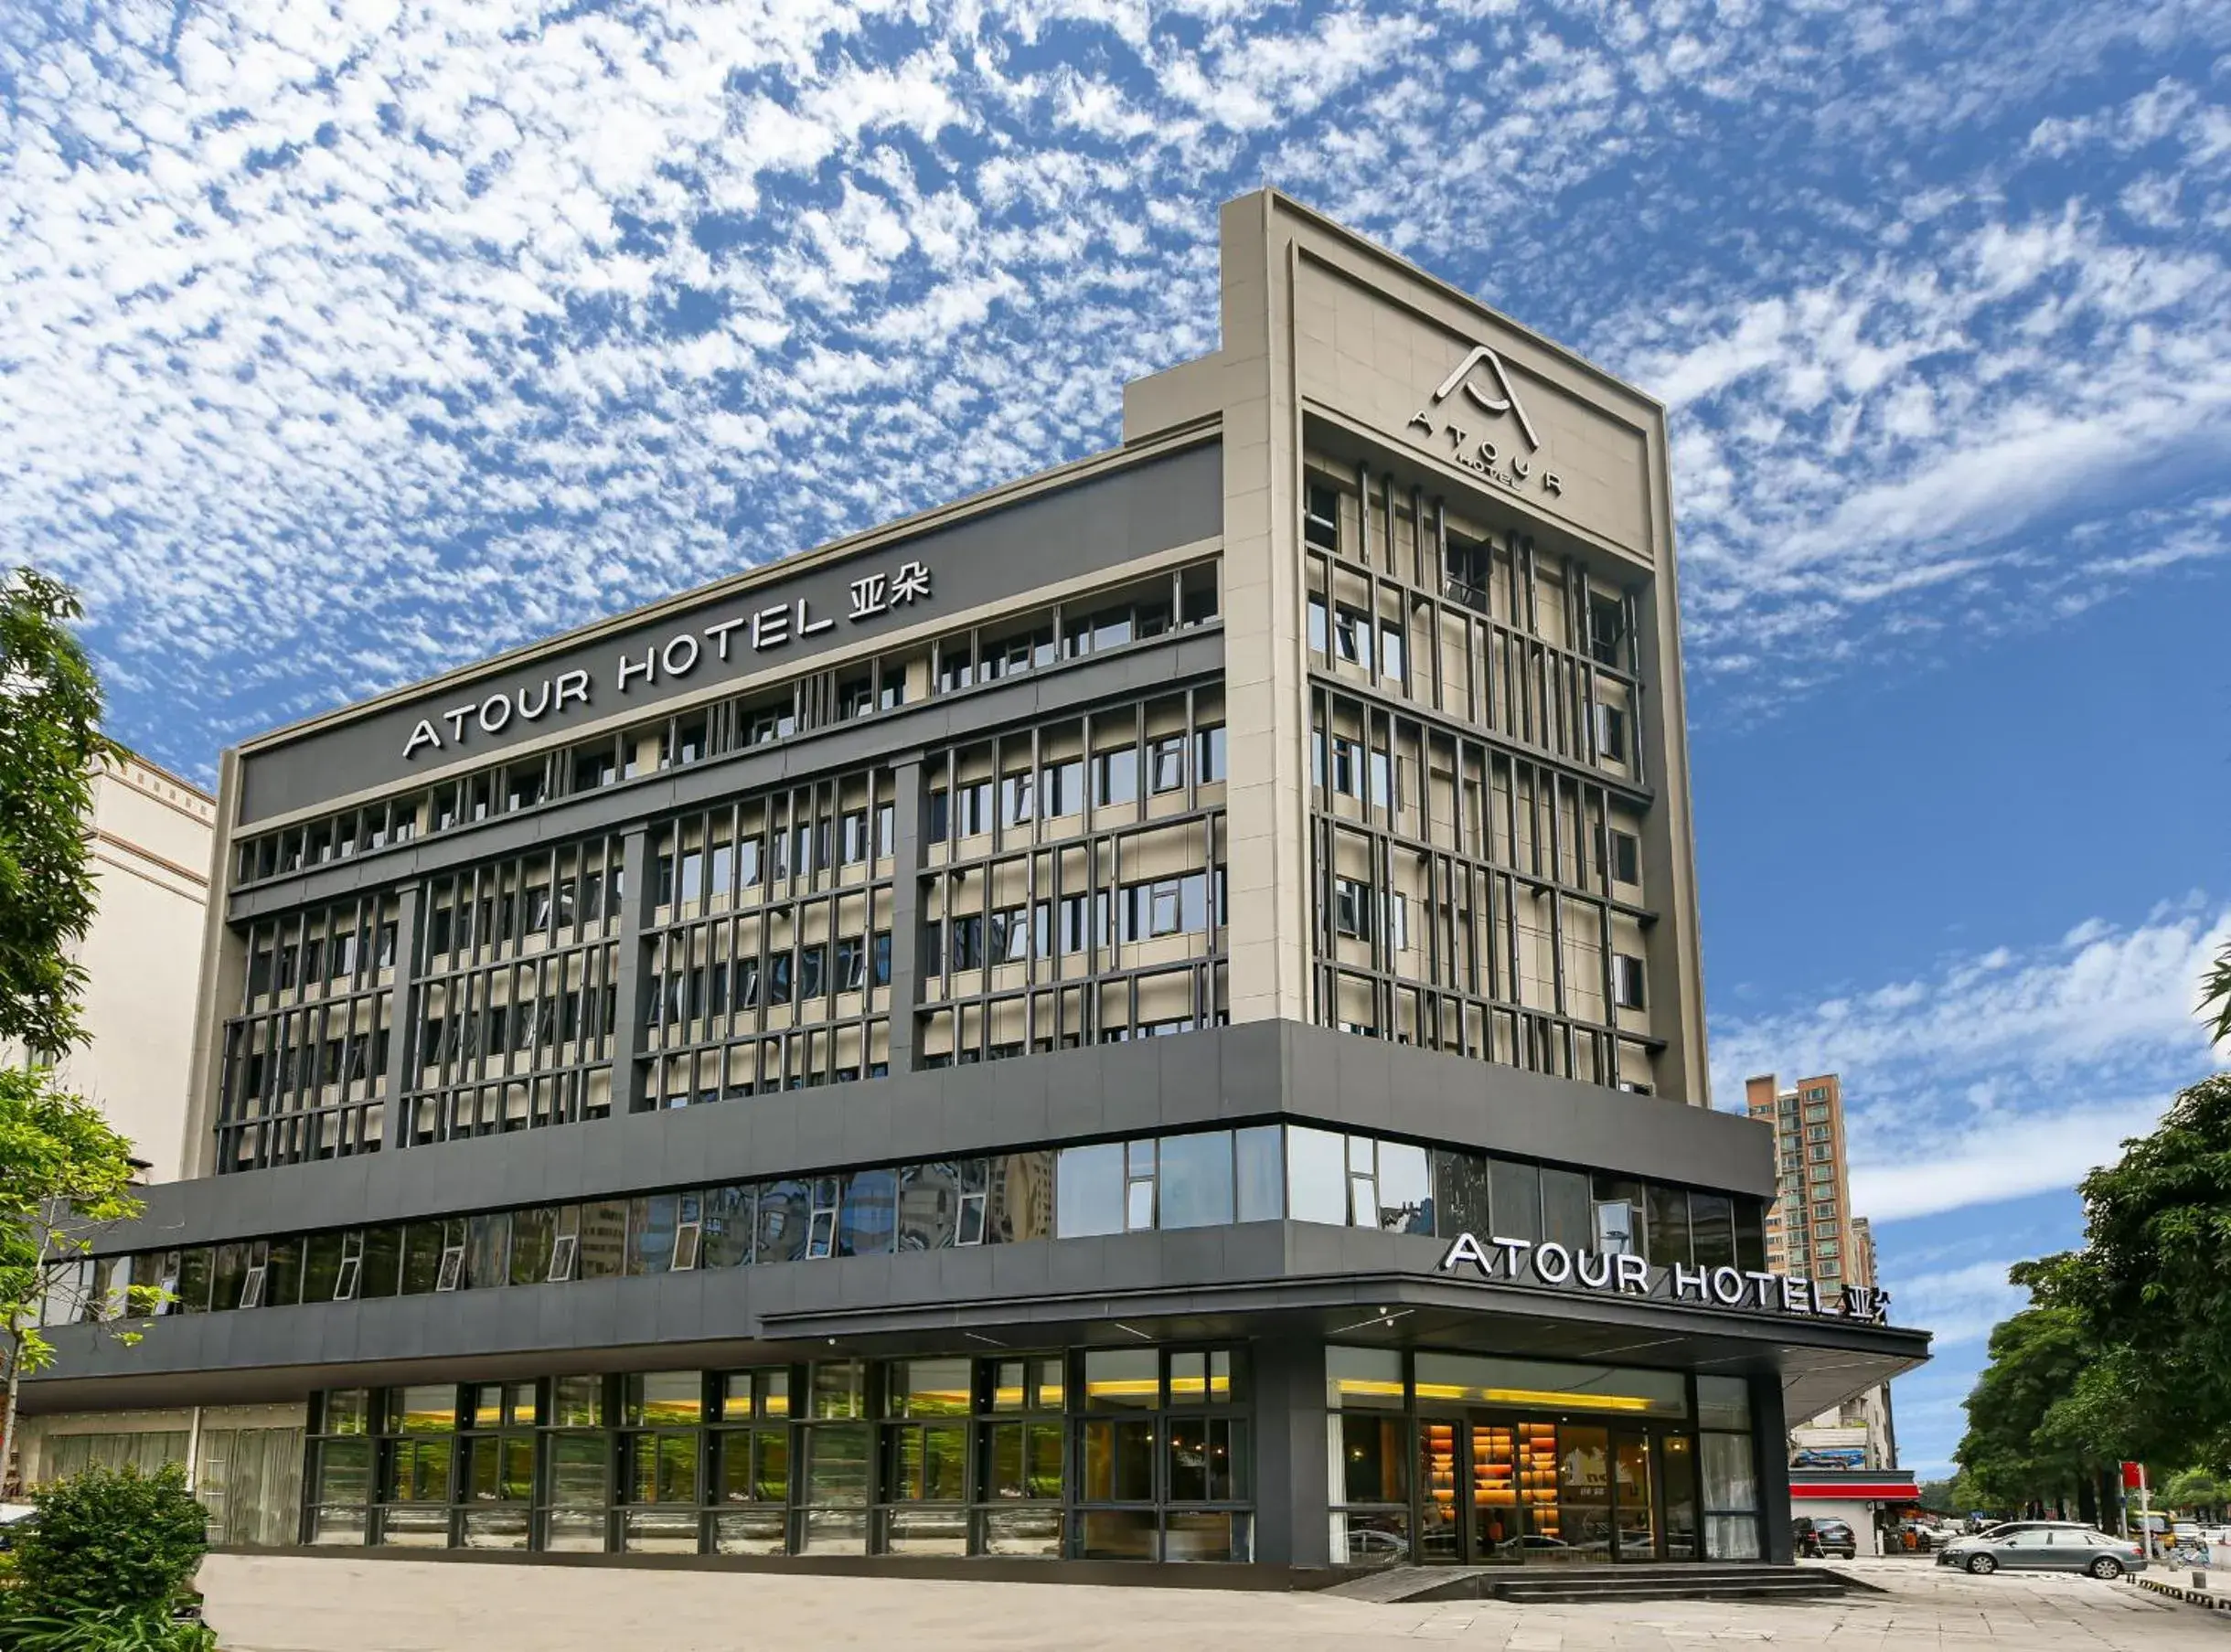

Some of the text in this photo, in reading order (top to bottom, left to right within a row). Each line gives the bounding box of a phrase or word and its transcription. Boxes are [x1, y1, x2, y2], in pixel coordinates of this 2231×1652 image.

[1409, 410, 1563, 494] ATOUR
[1457, 453, 1521, 492] HOTEL
[402, 560, 929, 758] ATOUR HOTEL 亚朵
[1443, 1232, 1649, 1295] ATOUR
[1674, 1261, 1841, 1315] HOTEL
